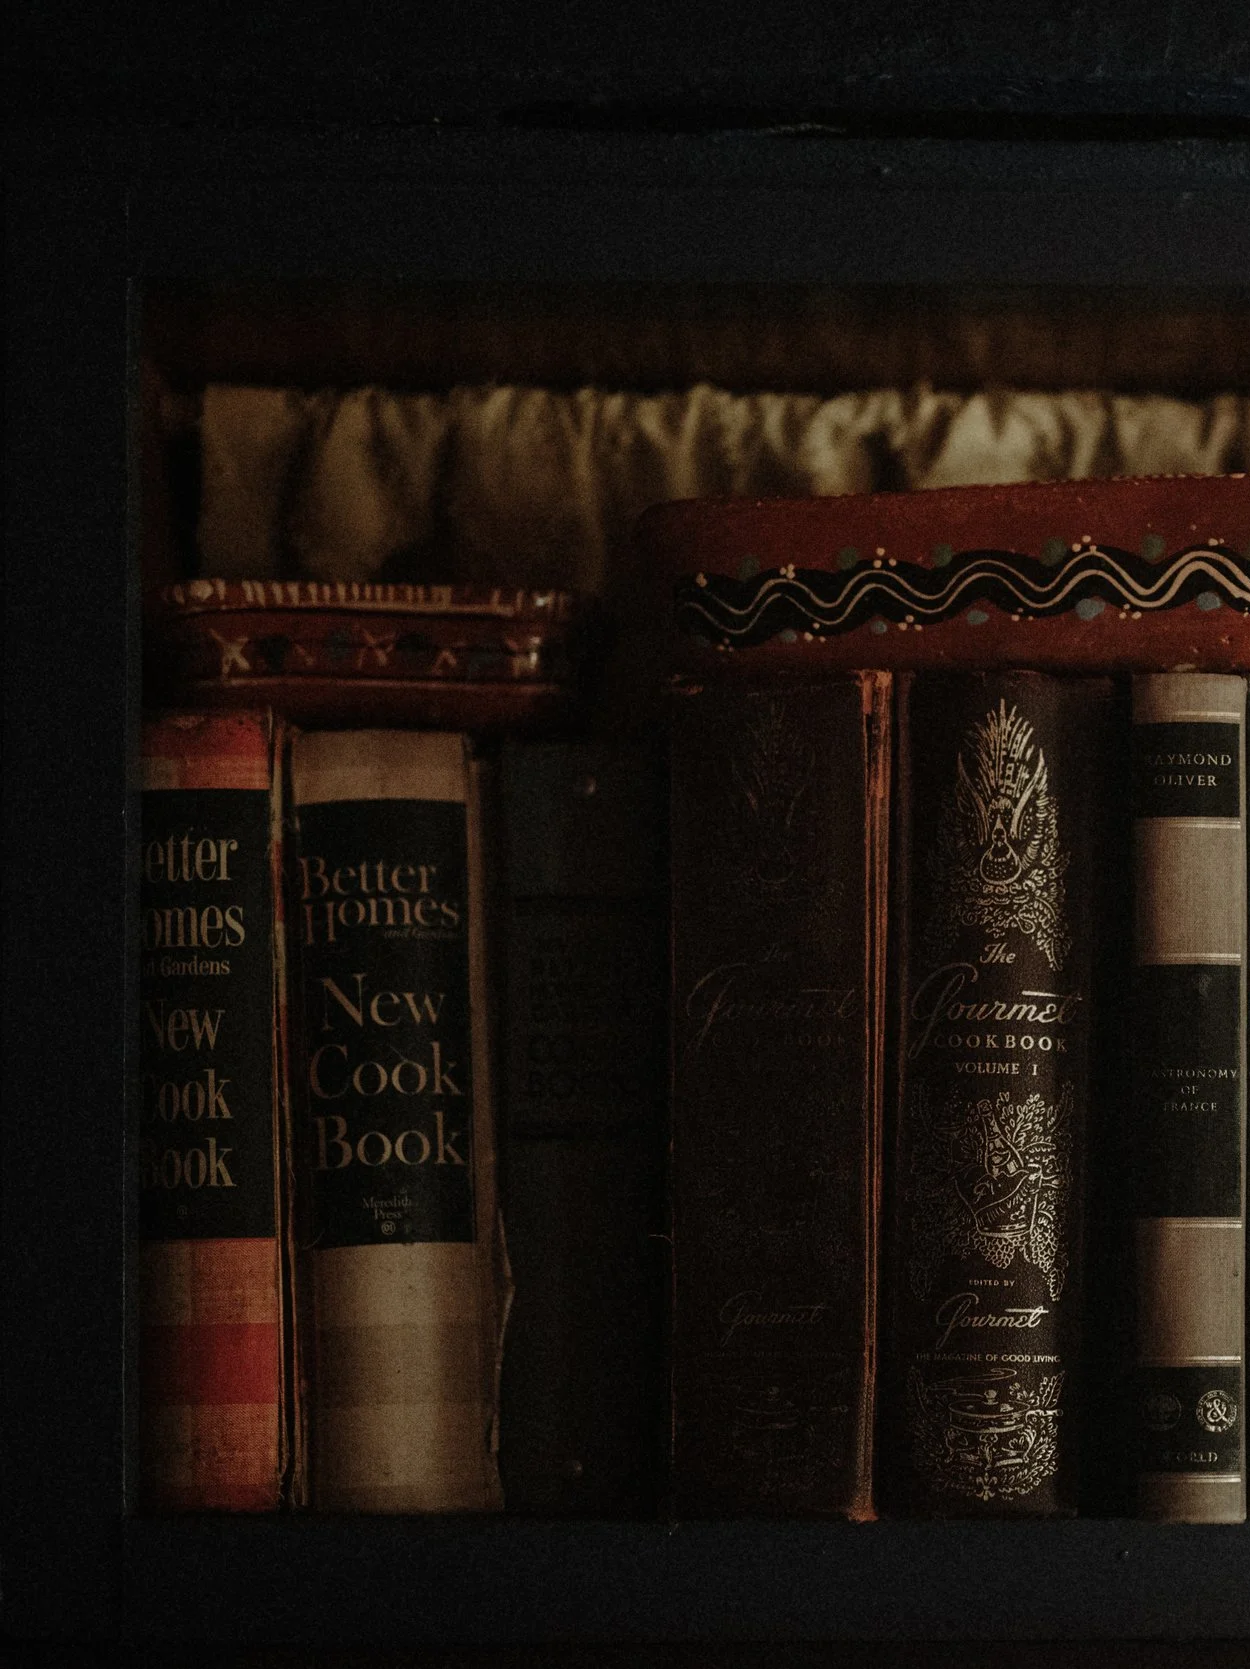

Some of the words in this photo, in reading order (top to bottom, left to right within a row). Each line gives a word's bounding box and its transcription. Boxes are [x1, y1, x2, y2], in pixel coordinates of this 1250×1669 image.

[1154, 773, 1218, 787] OLIVER
[145, 833, 240, 883] etter
[297, 855, 437, 900] Better
[143, 904, 247, 949] omes
[303, 896, 461, 946] Homes
[159, 954, 231, 978] Gardens
[979, 942, 1016, 964] The
[321, 972, 447, 1033] New
[908, 962, 1083, 1060] Gourmet
[934, 1034, 1068, 1051] COOKBOOK
[309, 1040, 463, 1100] Cook
[955, 1062, 1020, 1075] VOLUME
[1031, 1063, 1038, 1076] I
[1146, 1068, 1238, 1080] ASTRONOMY
[144, 1067, 234, 1123] ook
[313, 1110, 467, 1172] Book
[968, 1279, 1000, 1287] EDITED
[1003, 1279, 1016, 1287] BY
[935, 1291, 1049, 1350] Gourmet
[985, 1353, 998, 1362] OF
[1001, 1354, 1031, 1363] GOOD
